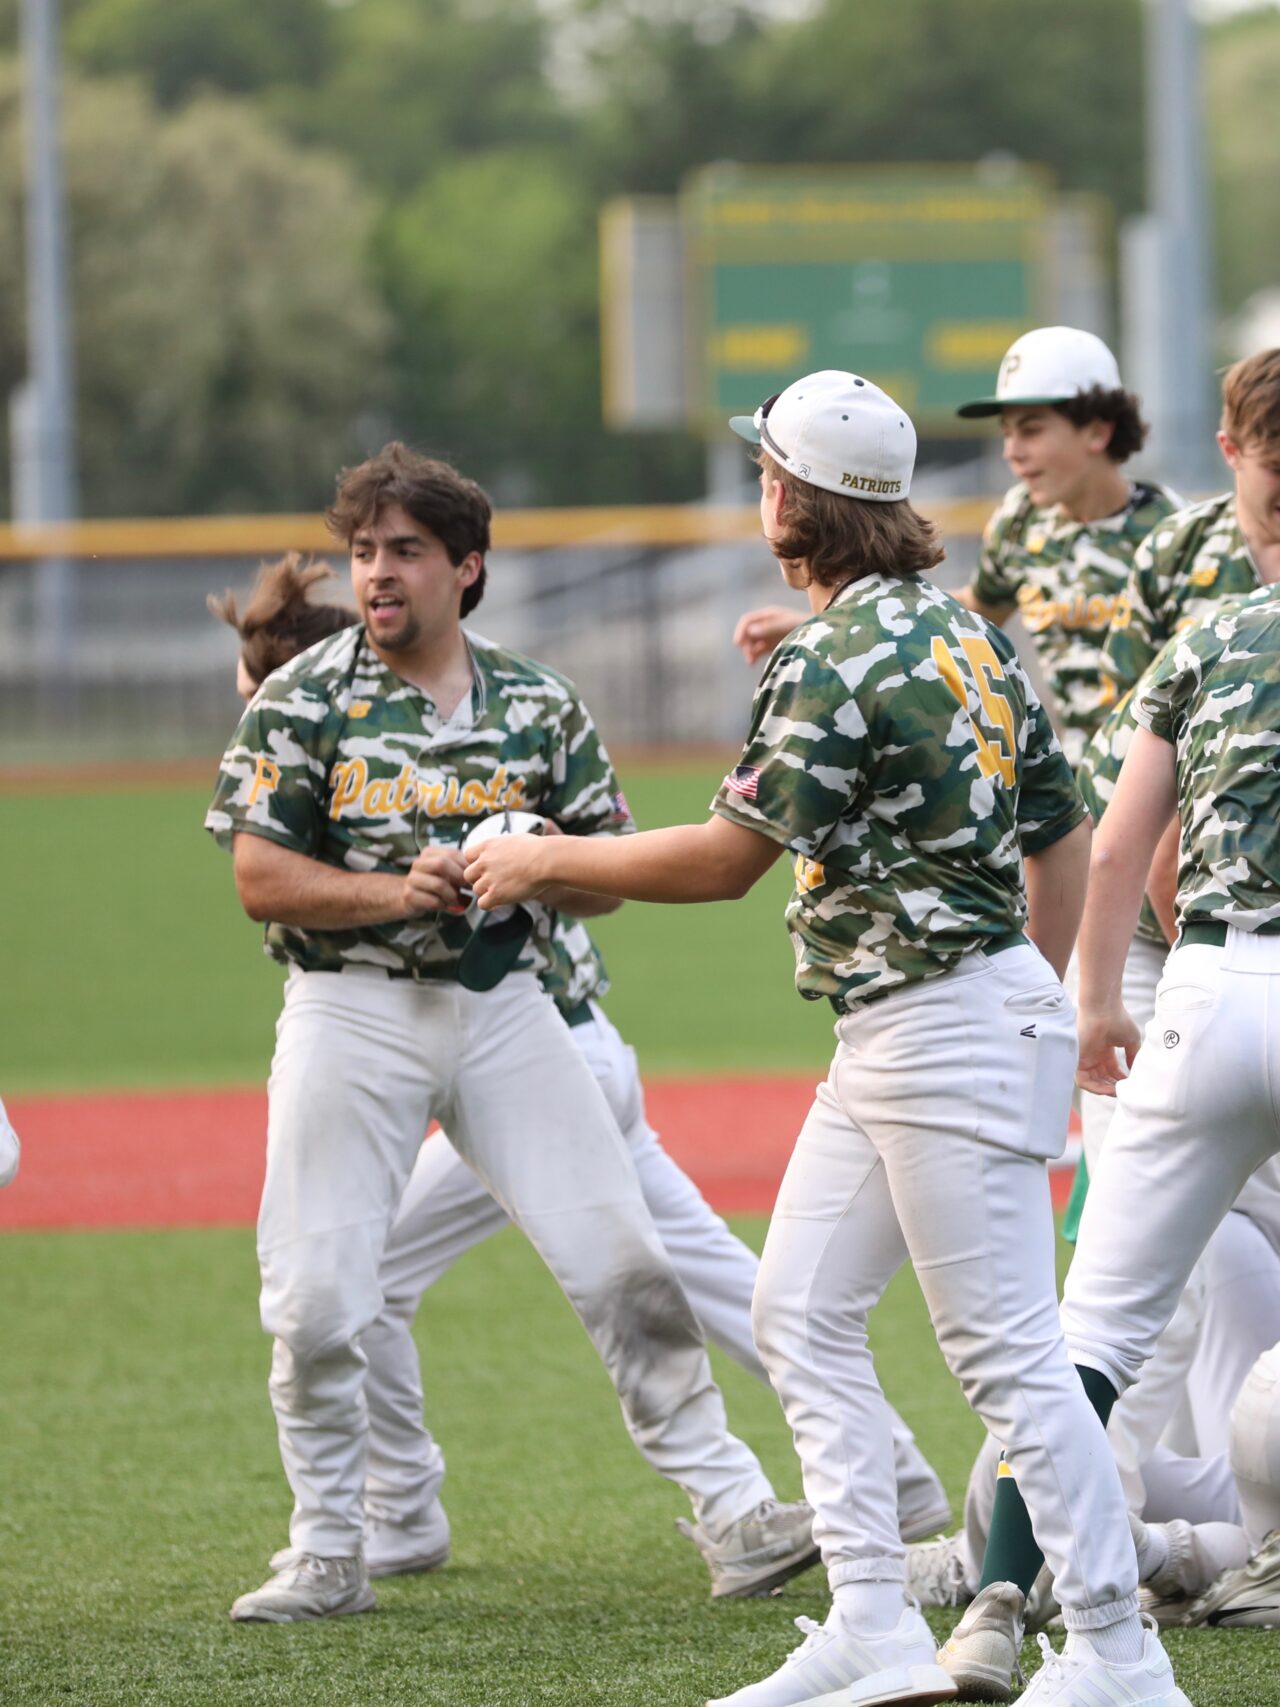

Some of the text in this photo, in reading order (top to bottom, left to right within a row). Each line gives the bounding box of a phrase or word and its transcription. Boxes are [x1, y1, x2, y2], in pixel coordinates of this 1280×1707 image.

[840, 472, 902, 494] PATRIOTS
[930, 636, 1016, 790] 15
[246, 756, 282, 806] P
[328, 756, 526, 821] Patriots
